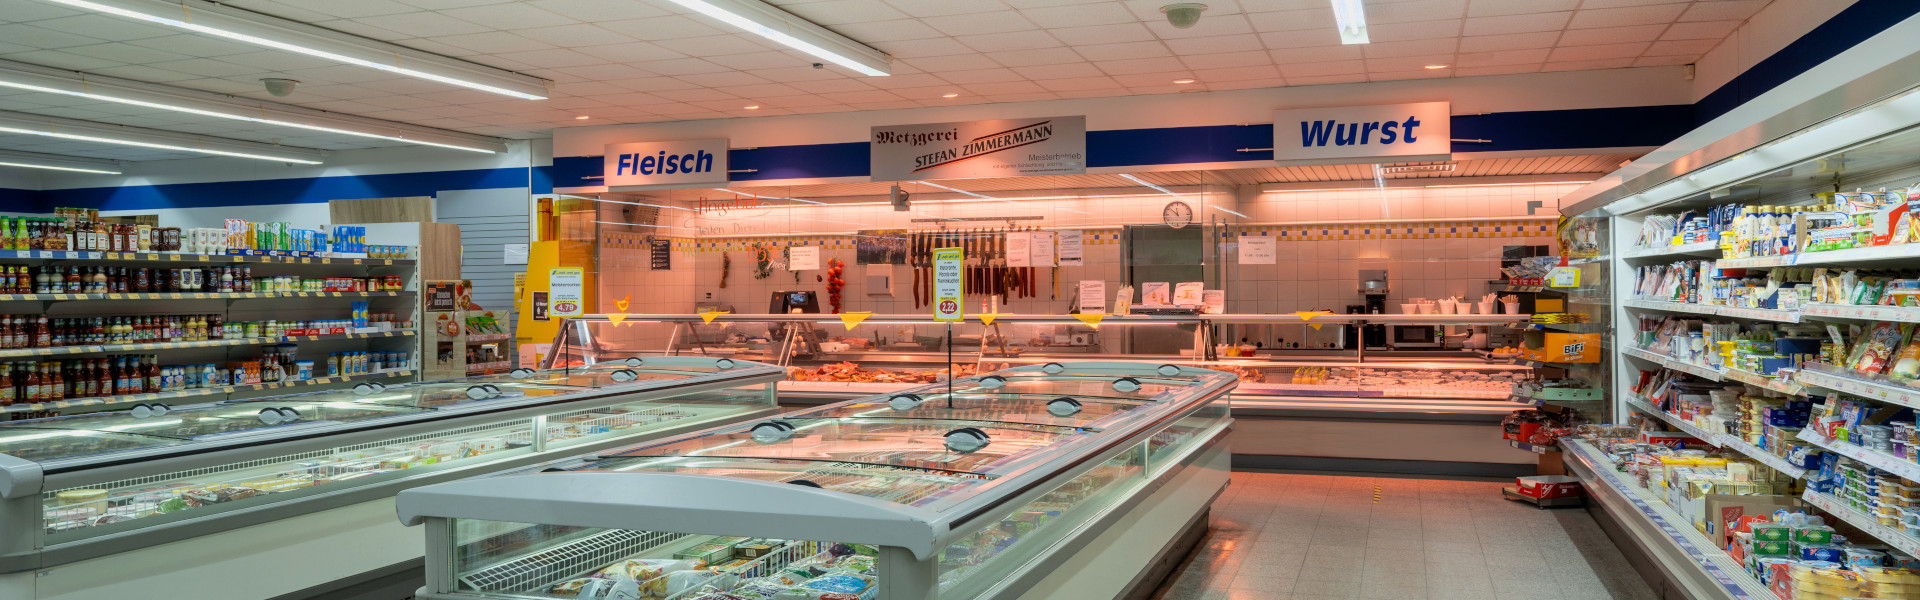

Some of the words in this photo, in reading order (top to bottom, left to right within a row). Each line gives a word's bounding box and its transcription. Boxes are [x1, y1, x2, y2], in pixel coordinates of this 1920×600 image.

[876, 127, 958, 147] Metzgerei
[1300, 115, 1421, 148] Wurst
[914, 147, 958, 168] STEFAN
[962, 124, 1053, 157] ZIMMERMANN
[617, 150, 714, 176] Fleisch
[1028, 152, 1082, 161] Meisterbetrieb
[699, 193, 758, 217] Angebot
[558, 303, 574, 312] 4,79
[942, 302, 955, 314] 2,22
[1563, 342, 1584, 355] BiFi
